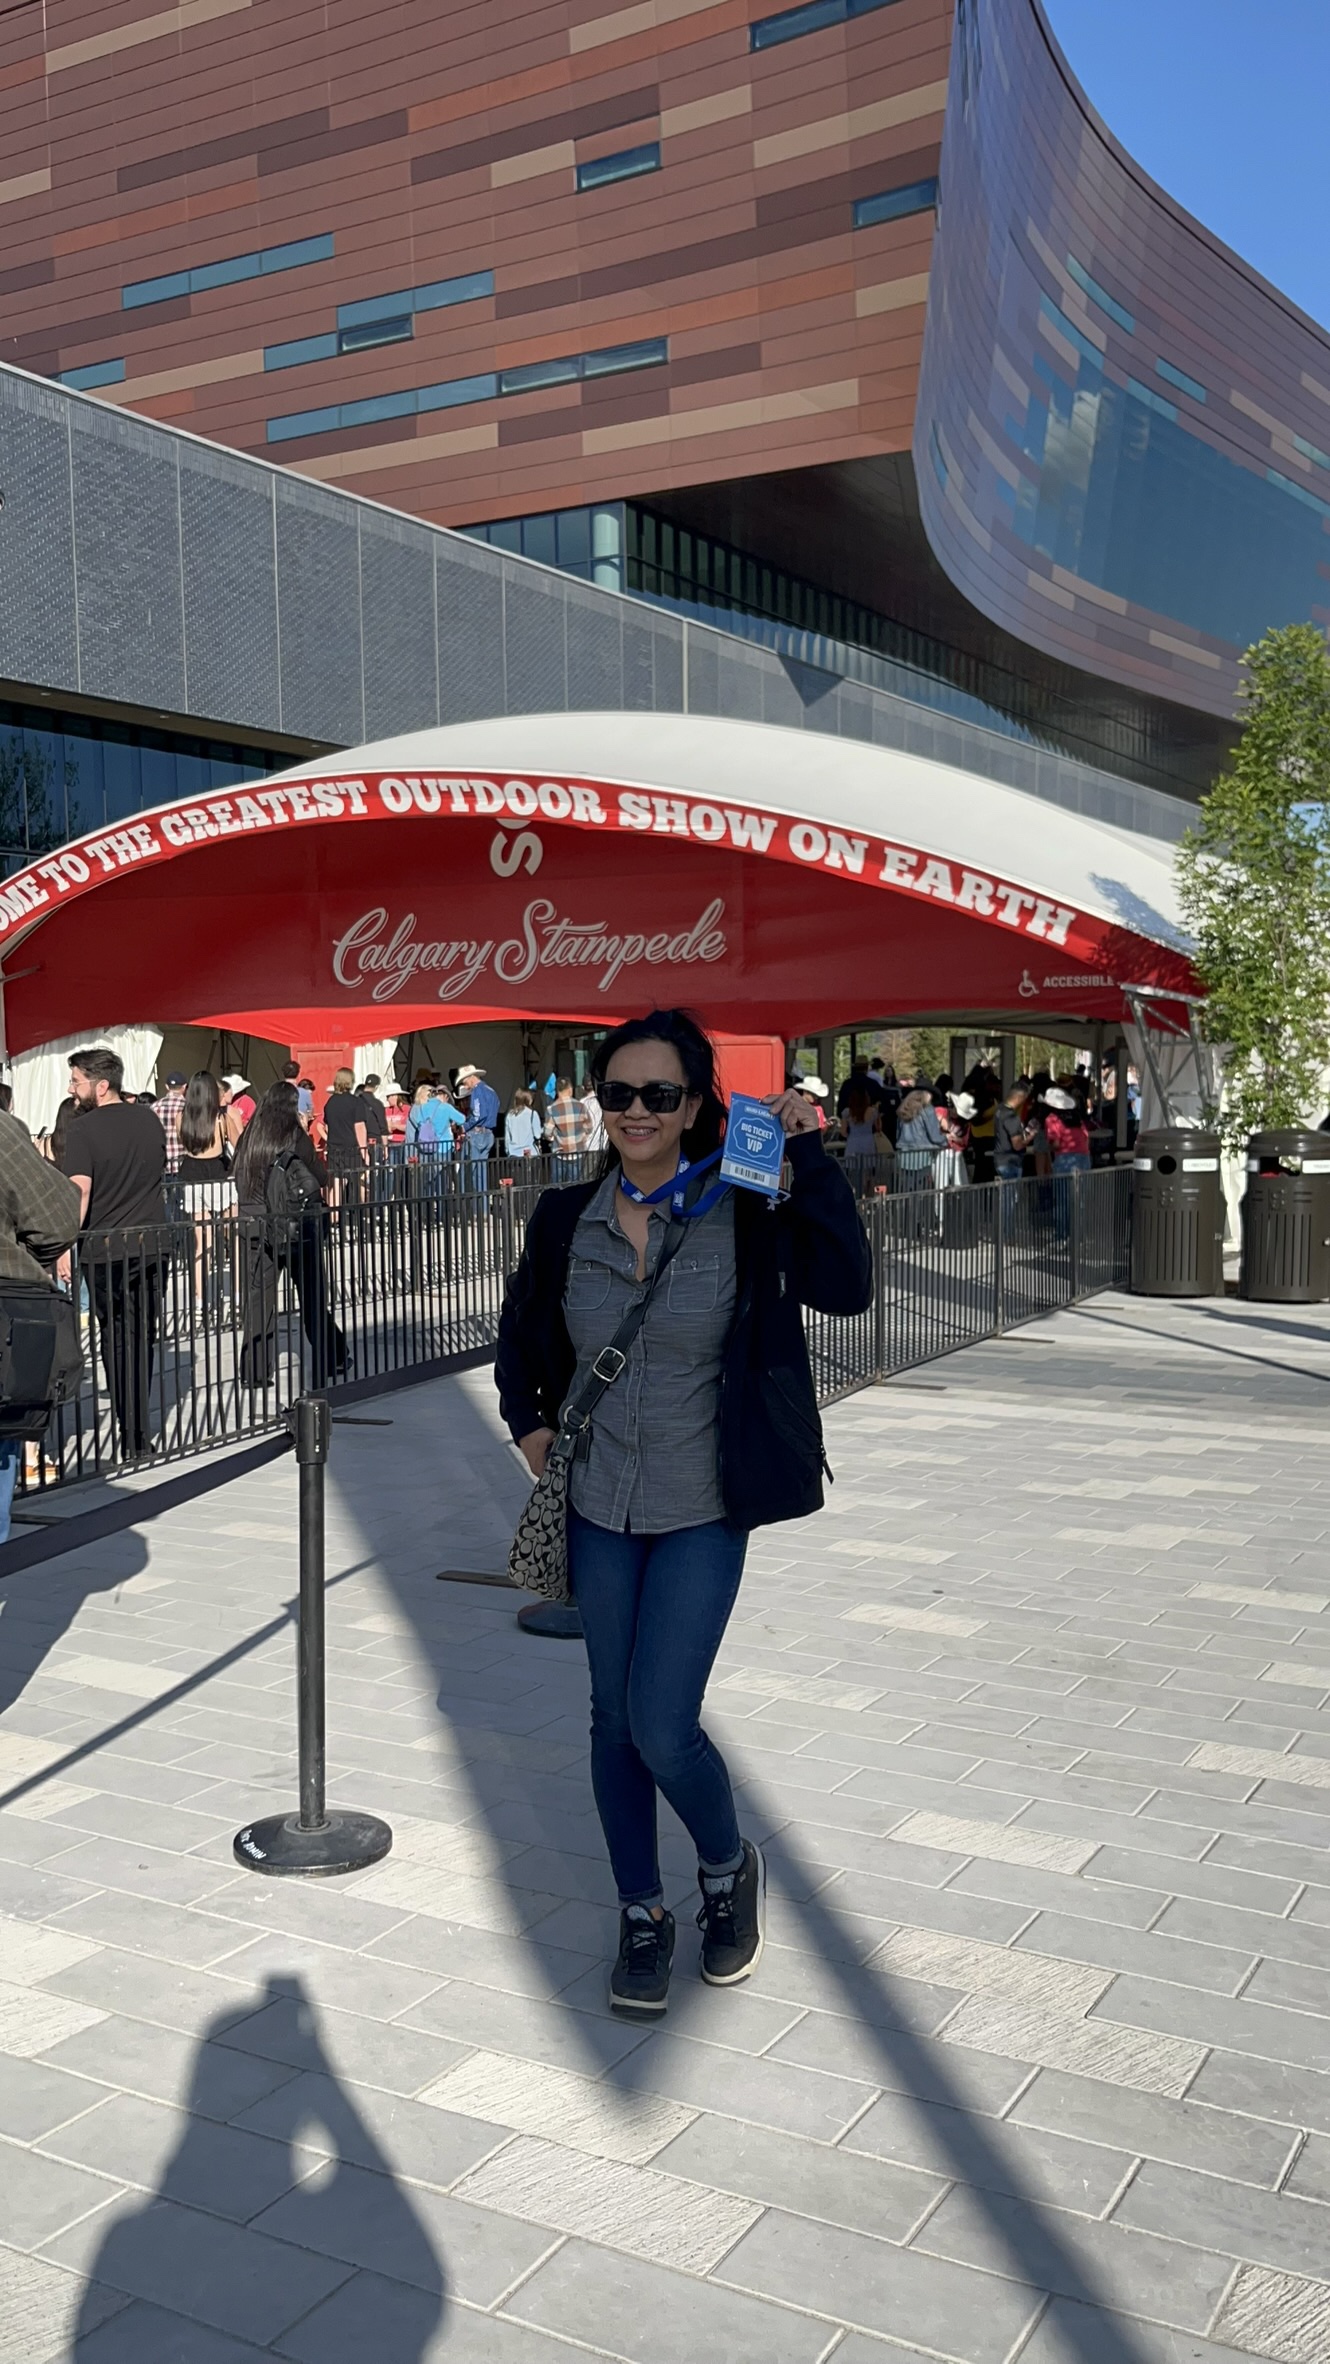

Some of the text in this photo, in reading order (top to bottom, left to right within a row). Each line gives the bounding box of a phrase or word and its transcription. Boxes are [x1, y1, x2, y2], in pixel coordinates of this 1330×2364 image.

[37, 853, 91, 893] TO
[83, 823, 162, 873] THE
[160, 780, 368, 846] GREATEST
[379, 778, 608, 824] OUTDOOR
[618, 792, 778, 854] SHOW
[788, 824, 869, 875] ON
[879, 846, 1076, 946] EARTH
[333, 899, 728, 1002] Calgary Stampede
[1042, 975, 1115, 988] ACCESSIBLE
[741, 1122, 752, 1134] BIG
[752, 1126, 773, 1140] TICKET
[747, 1138, 763, 1153] VIP
